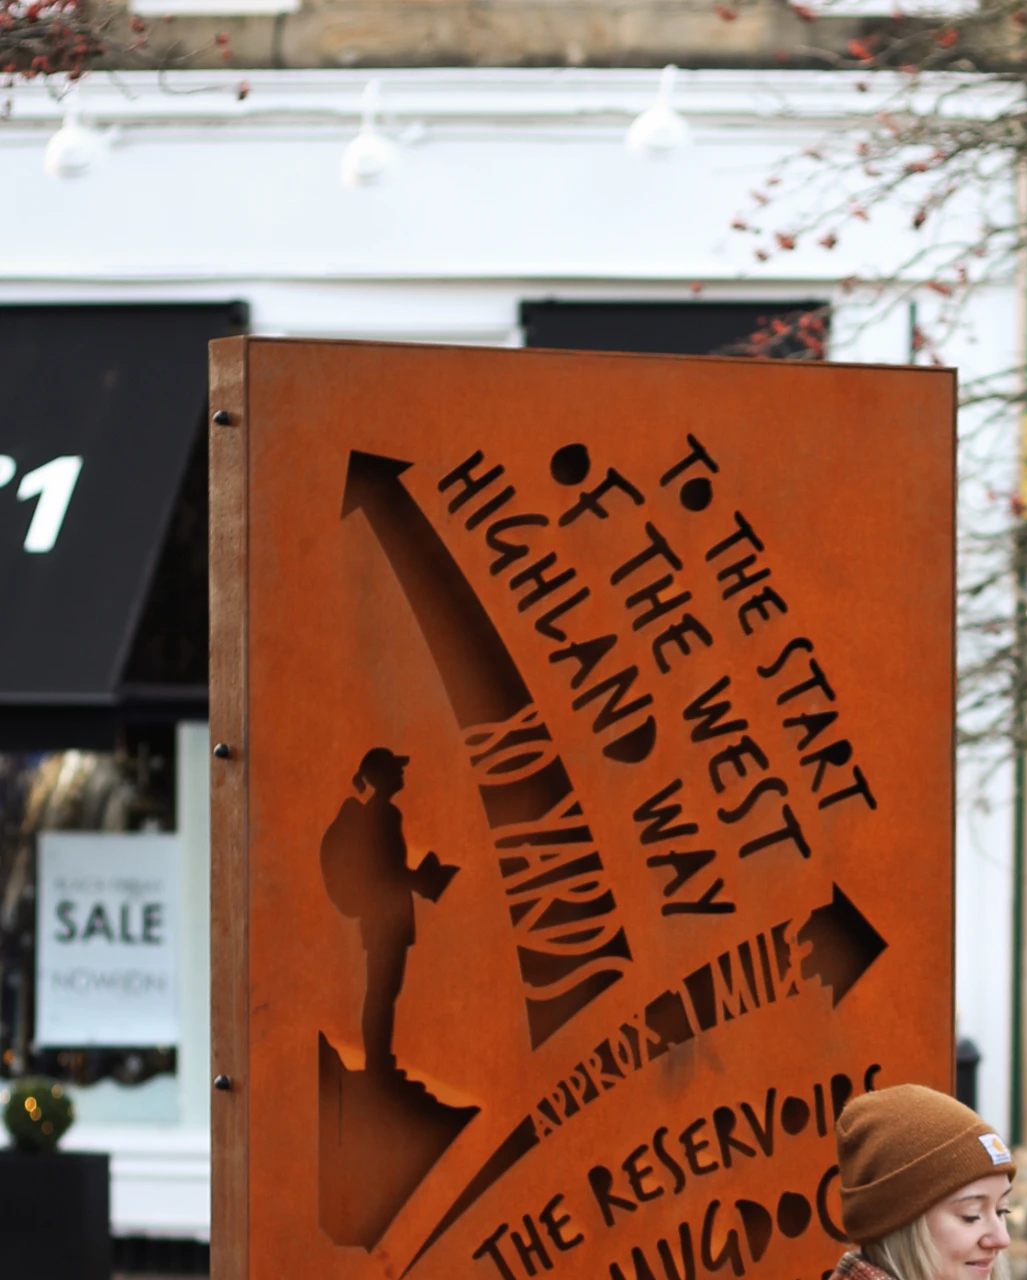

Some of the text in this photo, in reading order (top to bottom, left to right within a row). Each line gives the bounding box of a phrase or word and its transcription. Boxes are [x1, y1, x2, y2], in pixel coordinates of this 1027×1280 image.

[437, 449, 737, 918] HIGHLAND WAY
[549, 443, 812, 860] OF THE WEST
[659, 432, 878, 811] TO THE START
[54, 899, 165, 946] SALE
[491, 787, 634, 1001] YARDS
[533, 1012, 666, 1138] APPROX
